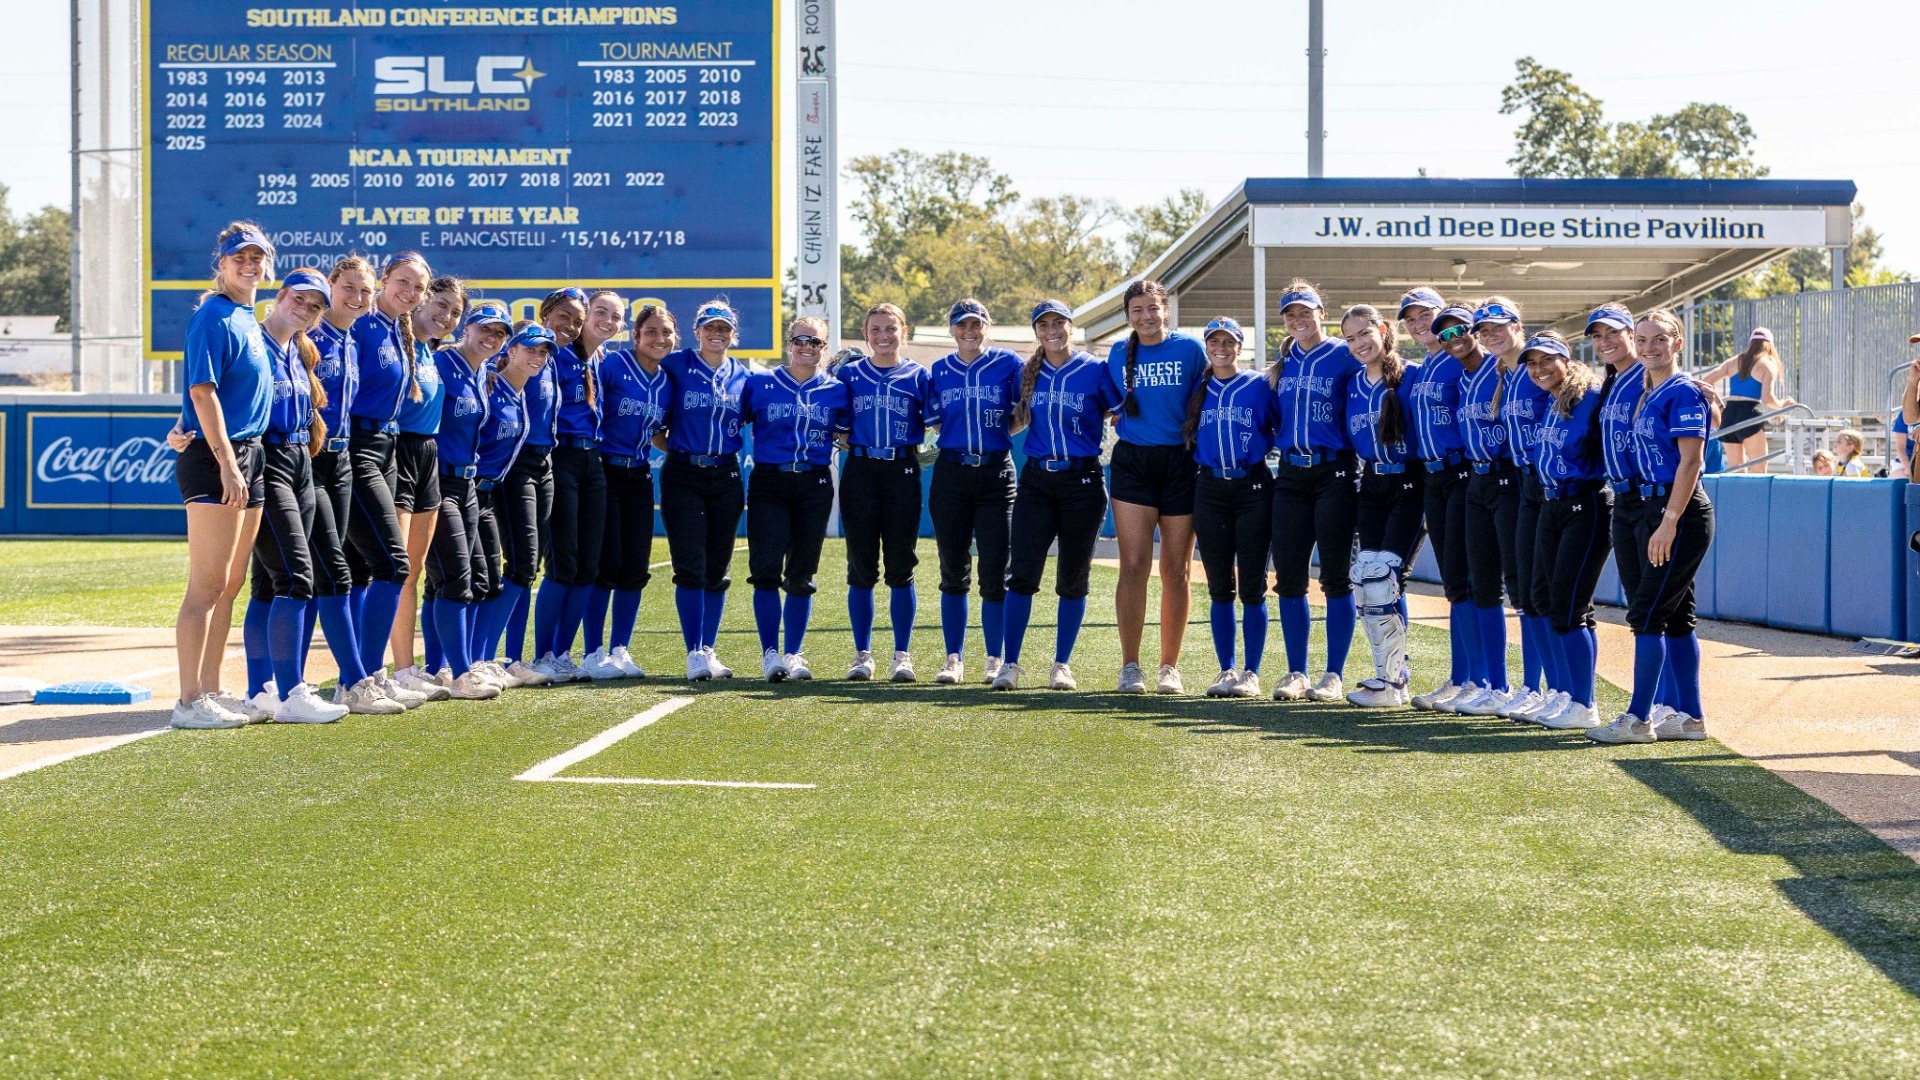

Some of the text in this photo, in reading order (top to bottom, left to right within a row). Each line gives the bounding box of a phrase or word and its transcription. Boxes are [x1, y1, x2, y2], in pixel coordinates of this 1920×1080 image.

[247, 7, 677, 27] SOUTHLAND CONFERENCE CHAMPIONS
[168, 44, 331, 61] REGULAR SEASON
[600, 42, 732, 59] TOURNAMENT
[168, 71, 325, 85] 1983 1994 2013
[374, 55, 526, 95] SLC
[594, 69, 741, 83] 1983 2005 2010
[166, 92, 325, 107] 2014 2016 2017
[375, 98, 530, 111] SOUTHLAND
[593, 90, 740, 105] 2016 2017 2018
[167, 114, 322, 128] 2022 2023 2024
[593, 112, 737, 127] 2021 2022 2023
[166, 136, 205, 150] 2025
[349, 148, 571, 167] NCAA TOURNAMENT
[804, 135, 822, 177] FARE
[259, 172, 664, 187] 1994 2005 2010 2016 2017 2018 2021 2022
[257, 191, 297, 205] 2023
[804, 184, 822, 202] IZ
[341, 207, 579, 225] PLAYER OF THE YEAR
[1315, 215, 1765, 239] J.W. and Dee Dee Stine Pavilion
[268, 232, 343, 247] MOREAUX
[422, 232, 434, 246] E.
[441, 231, 545, 246] PIANCASTELLI
[1122, 361, 1182, 379] NEESE
[1123, 375, 1182, 390] SFTBALL
[940, 385, 1001, 409] COWGIRLS
[1030, 391, 1085, 413] OWGIRLS
[767, 402, 830, 426] COWGIRLS
[983, 409, 1004, 428] 17
[1200, 406, 1253, 428] OWGIRLS
[1313, 401, 1333, 423] 18
[1431, 405, 1452, 425] 15
[728, 418, 739, 438] 8
[1072, 416, 1082, 435] 1
[1240, 431, 1253, 453] 7
[1482, 424, 1507, 447] 10
